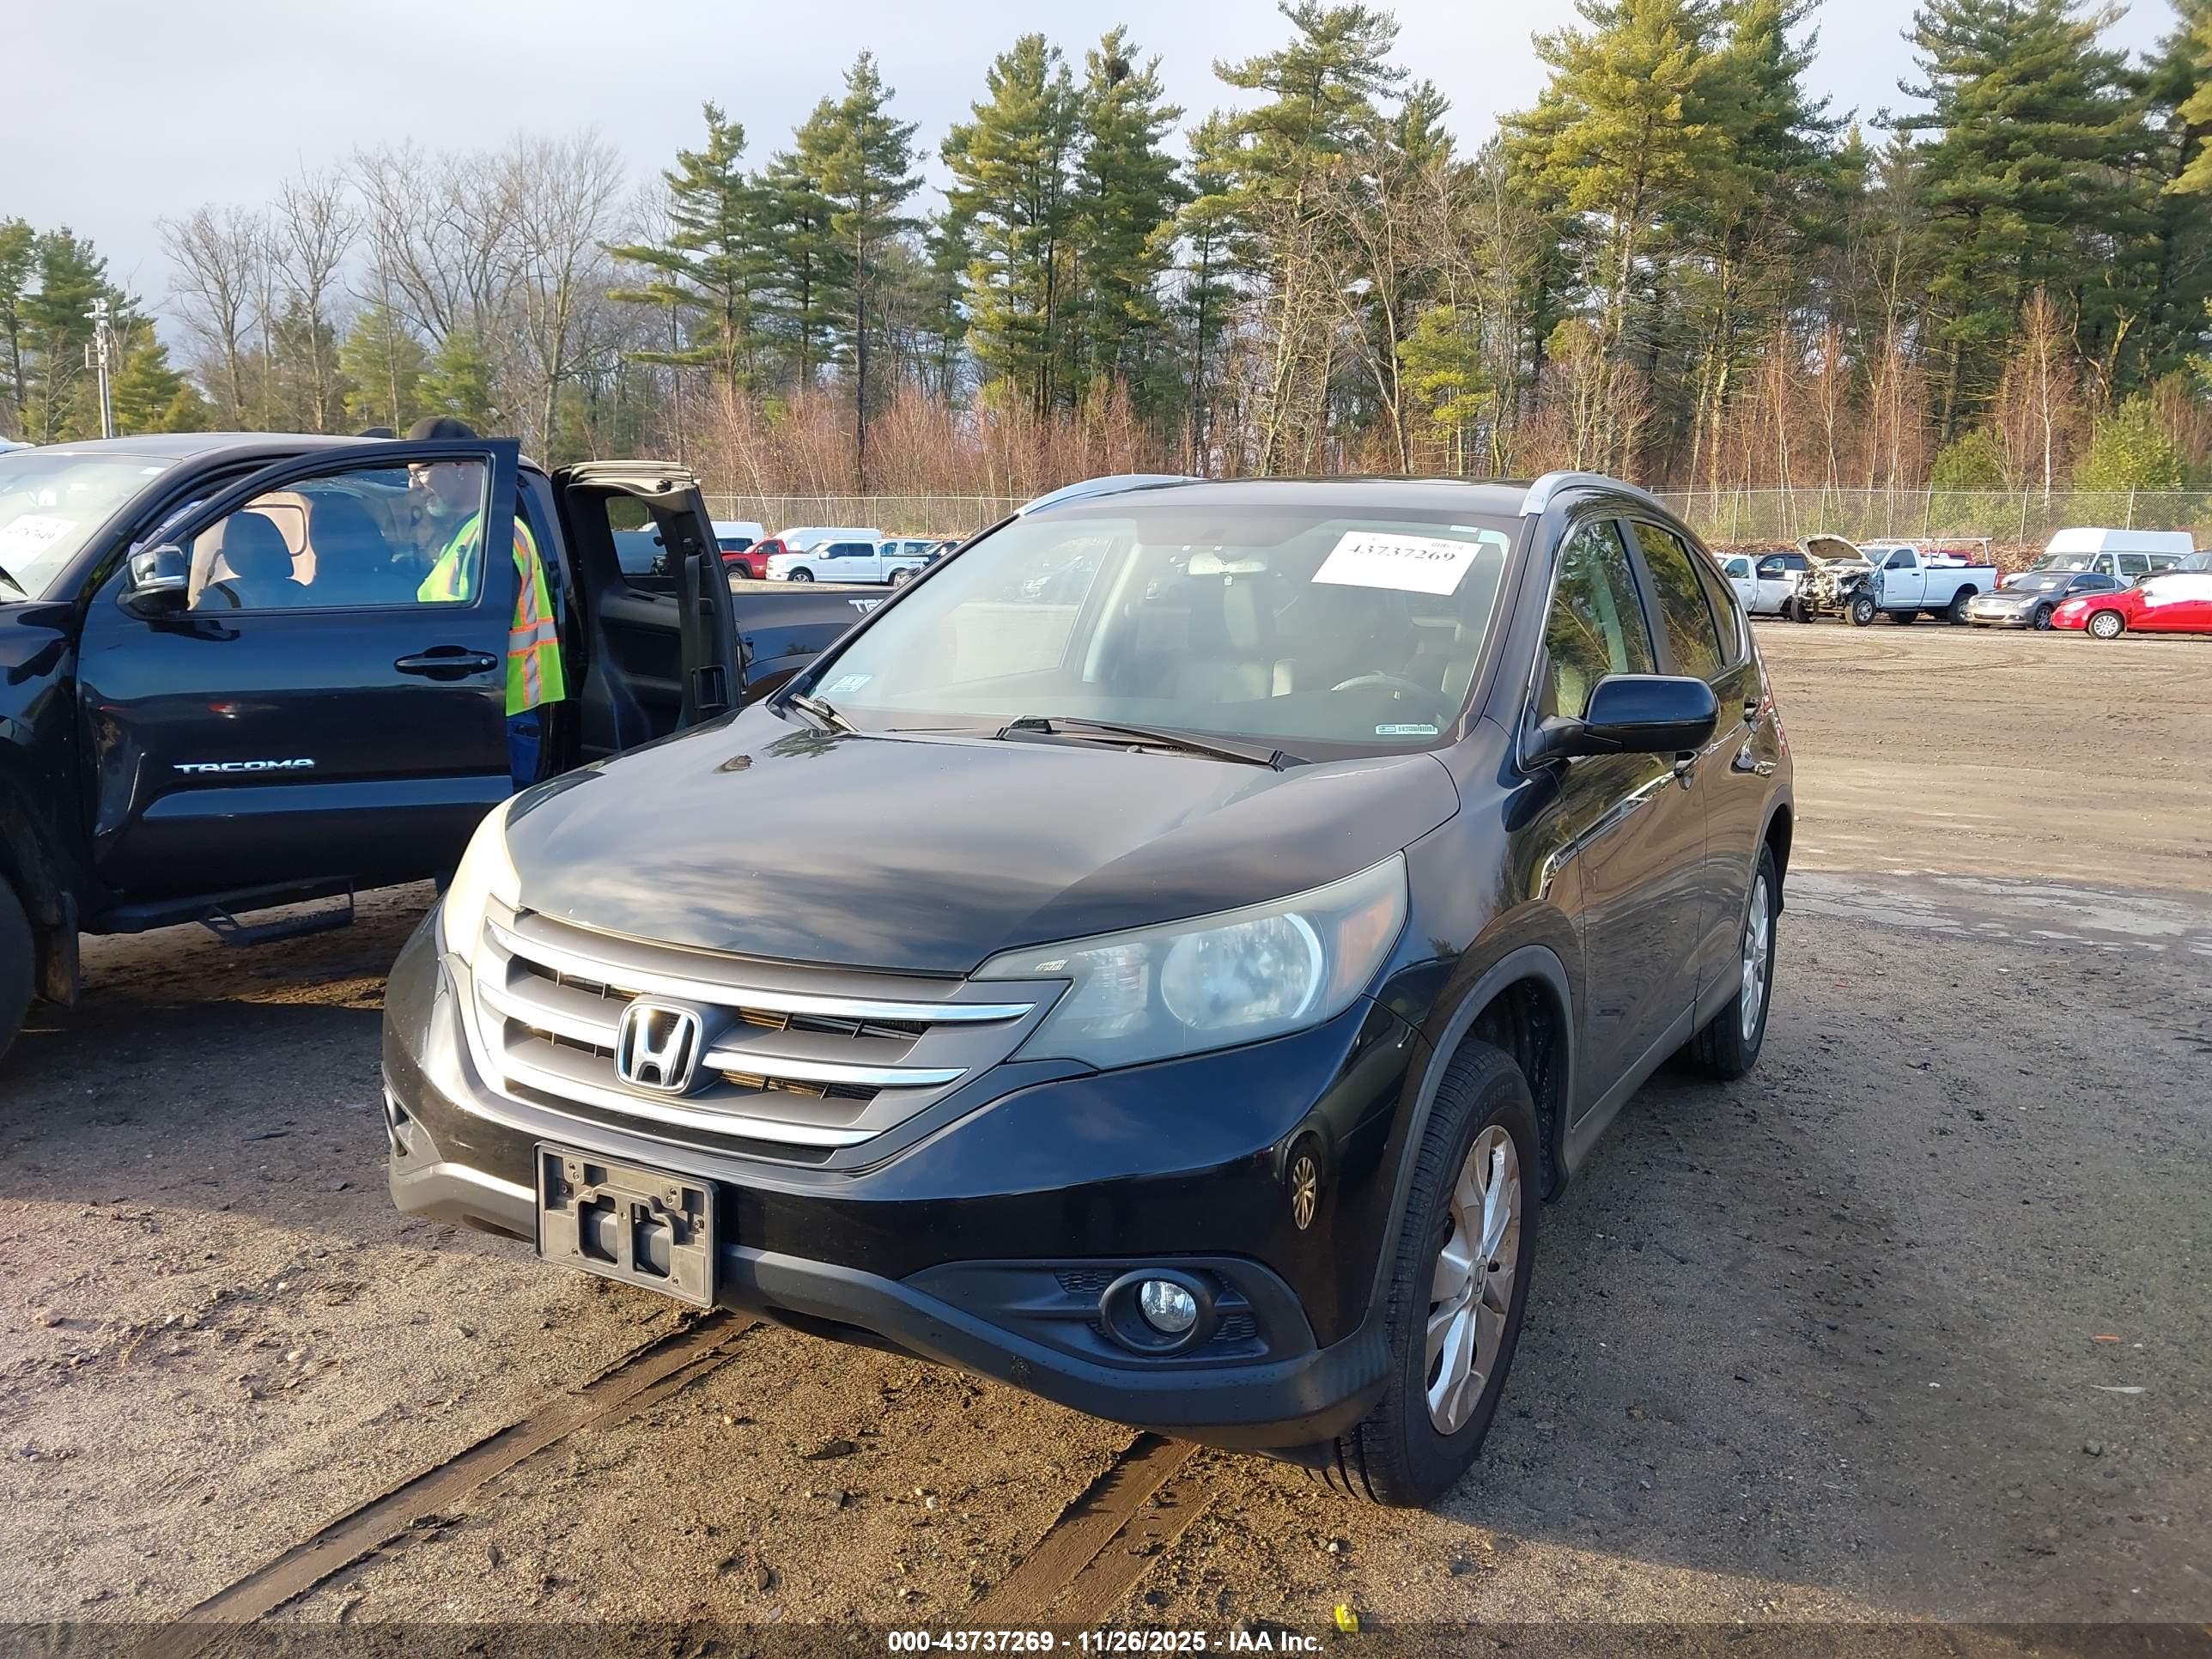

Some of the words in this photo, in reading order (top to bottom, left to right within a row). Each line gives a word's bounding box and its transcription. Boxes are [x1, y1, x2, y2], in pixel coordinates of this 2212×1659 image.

[1347, 543, 1456, 562] 43737269
[848, 599, 885, 613] TR
[173, 757, 316, 774] TACOMA
